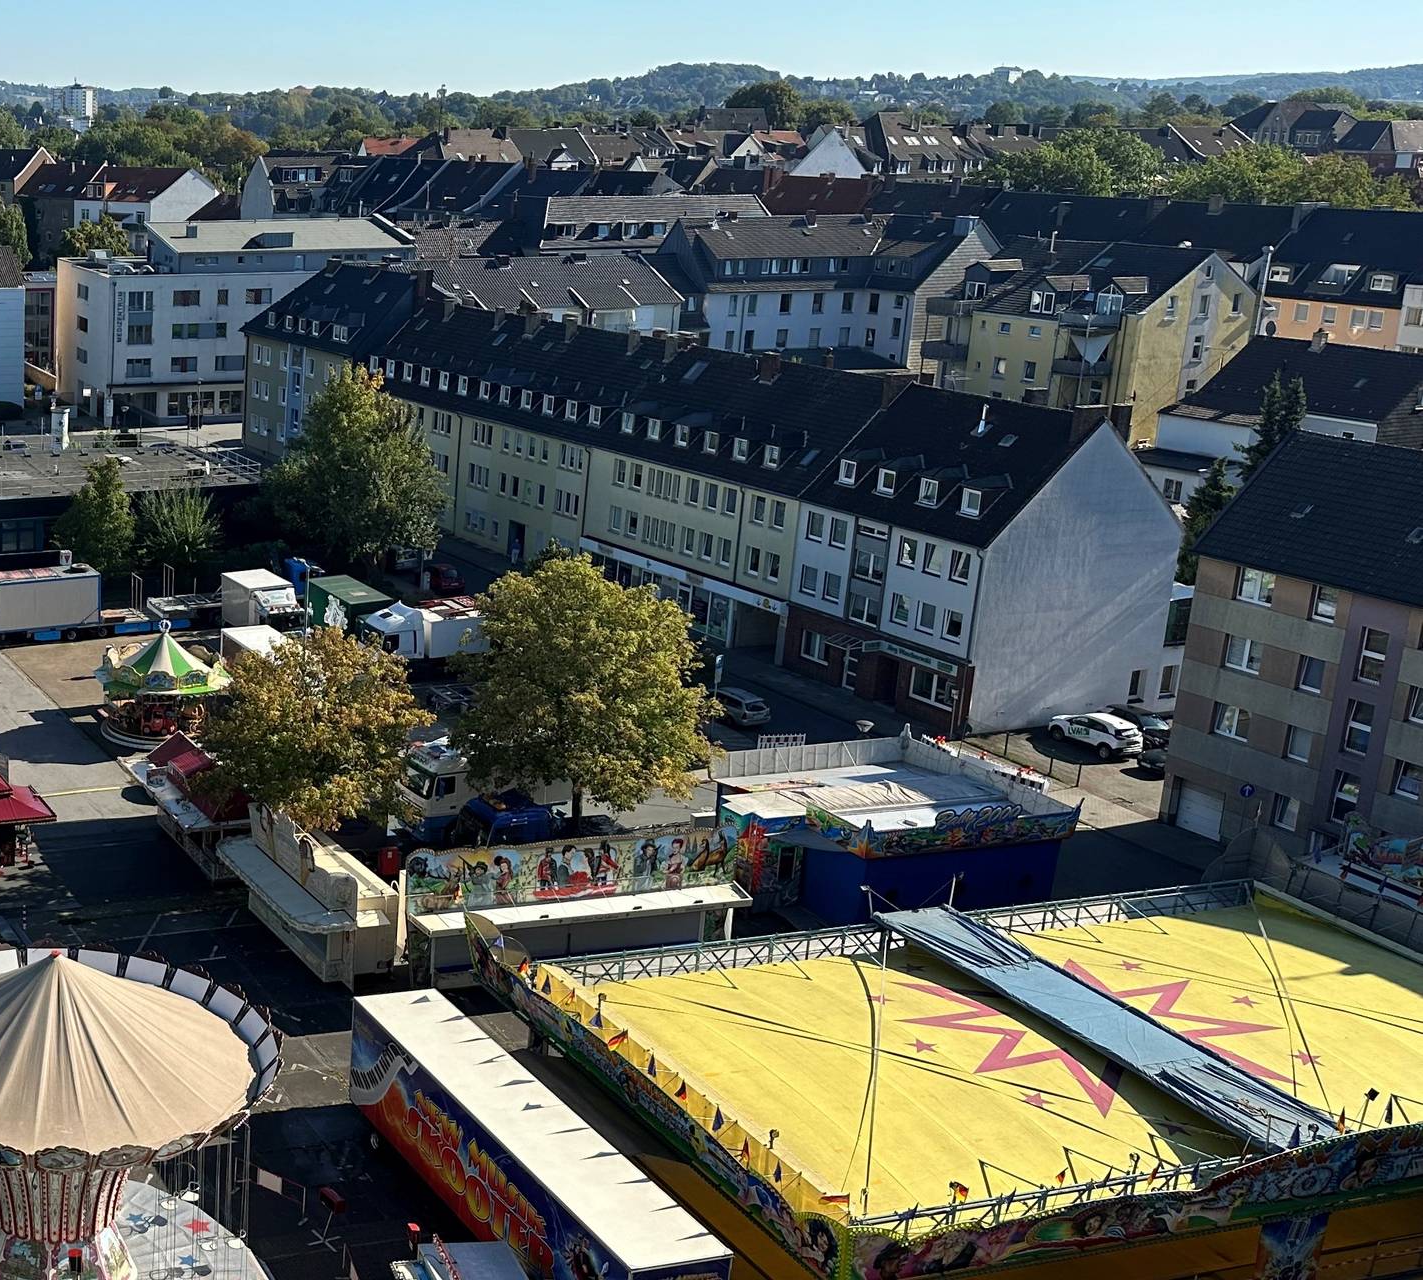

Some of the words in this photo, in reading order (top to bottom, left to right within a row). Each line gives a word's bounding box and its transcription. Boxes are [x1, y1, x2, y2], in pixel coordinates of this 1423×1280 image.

[973, 804, 1023, 828] 2000
[414, 1089, 465, 1152] NEW
[403, 1106, 555, 1280] SKOOTER
